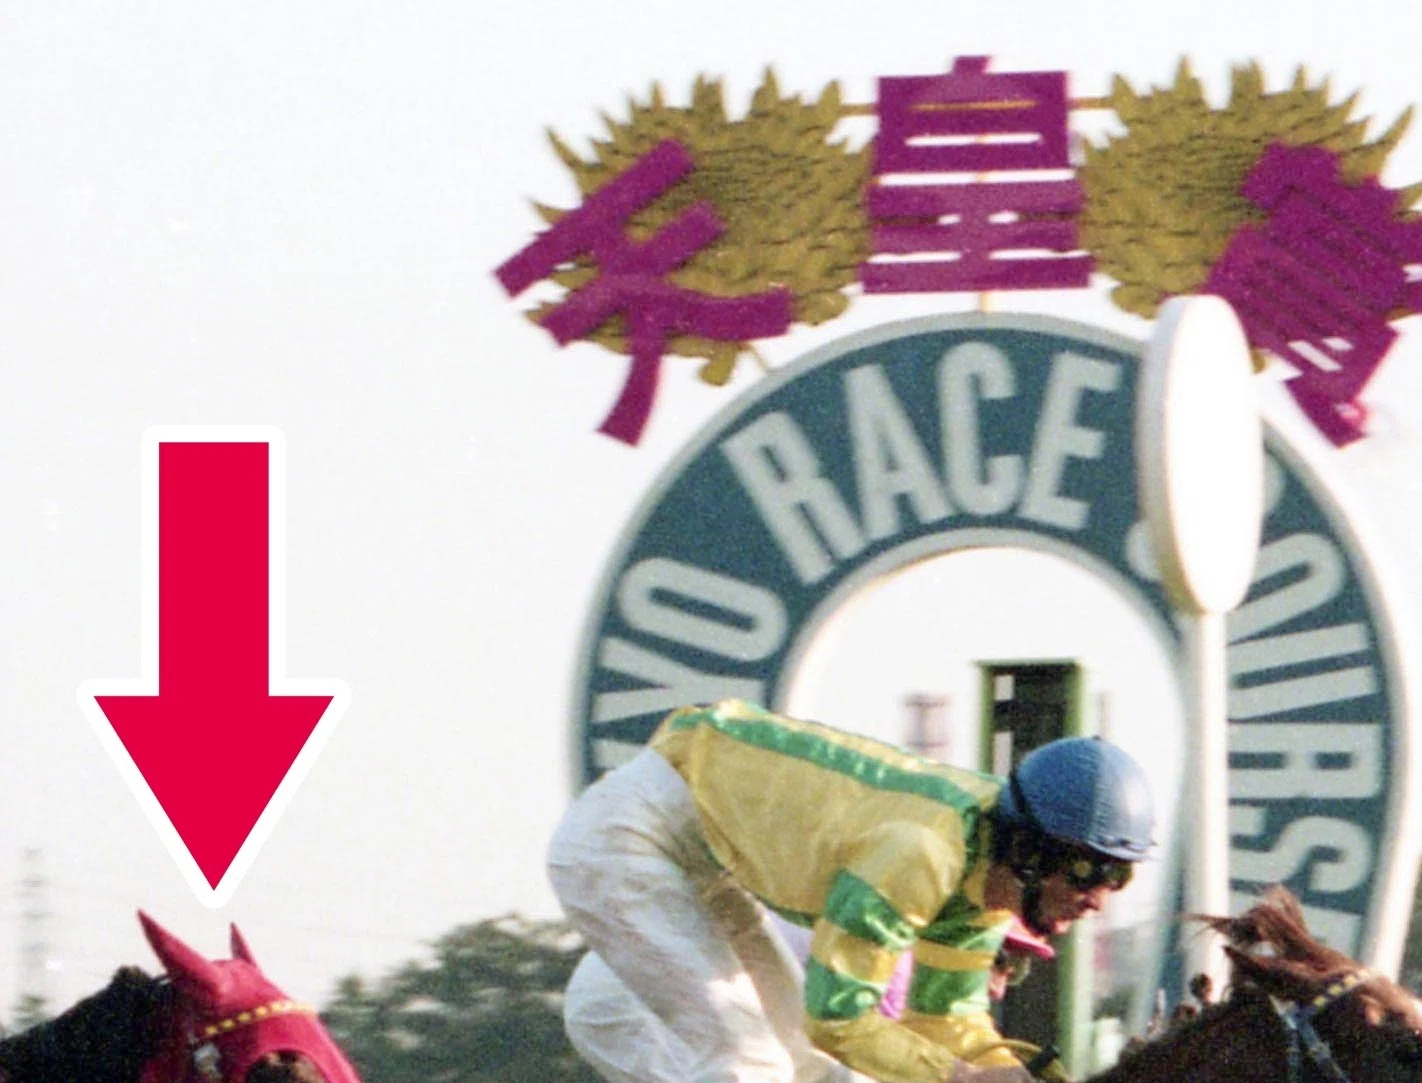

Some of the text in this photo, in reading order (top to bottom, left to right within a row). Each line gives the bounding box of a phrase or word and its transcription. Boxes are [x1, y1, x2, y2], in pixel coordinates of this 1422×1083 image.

[588, 341, 1387, 962] YO RACE OURS
